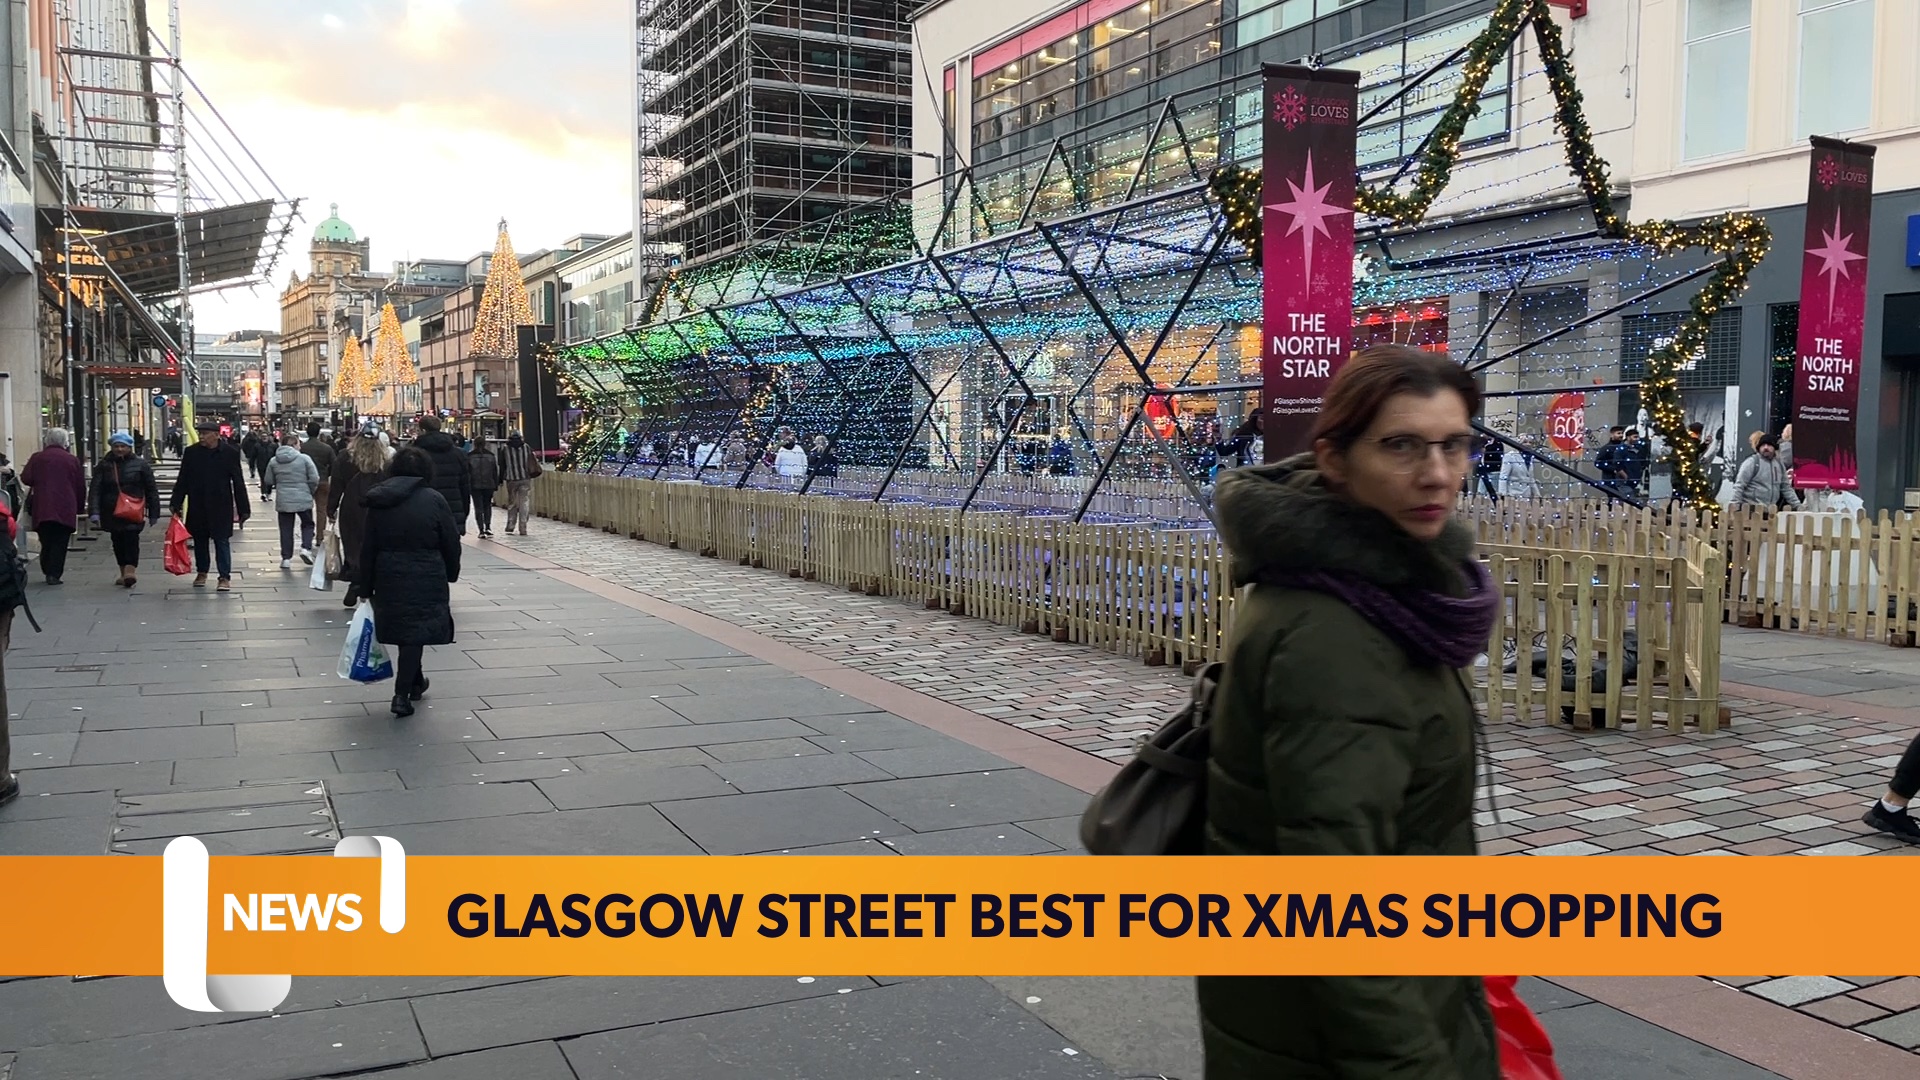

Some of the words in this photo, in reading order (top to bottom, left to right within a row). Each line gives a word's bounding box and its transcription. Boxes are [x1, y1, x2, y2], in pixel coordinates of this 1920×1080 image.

[1310, 105, 1349, 119] LOVES
[1841, 170, 1868, 184] LOVES
[1287, 313, 1326, 333] THE
[1273, 335, 1341, 356] NORTH
[1814, 337, 1843, 356] THE
[1282, 358, 1330, 378] STAR
[1802, 354, 1853, 375] NORTH
[1808, 374, 1845, 392] STAR
